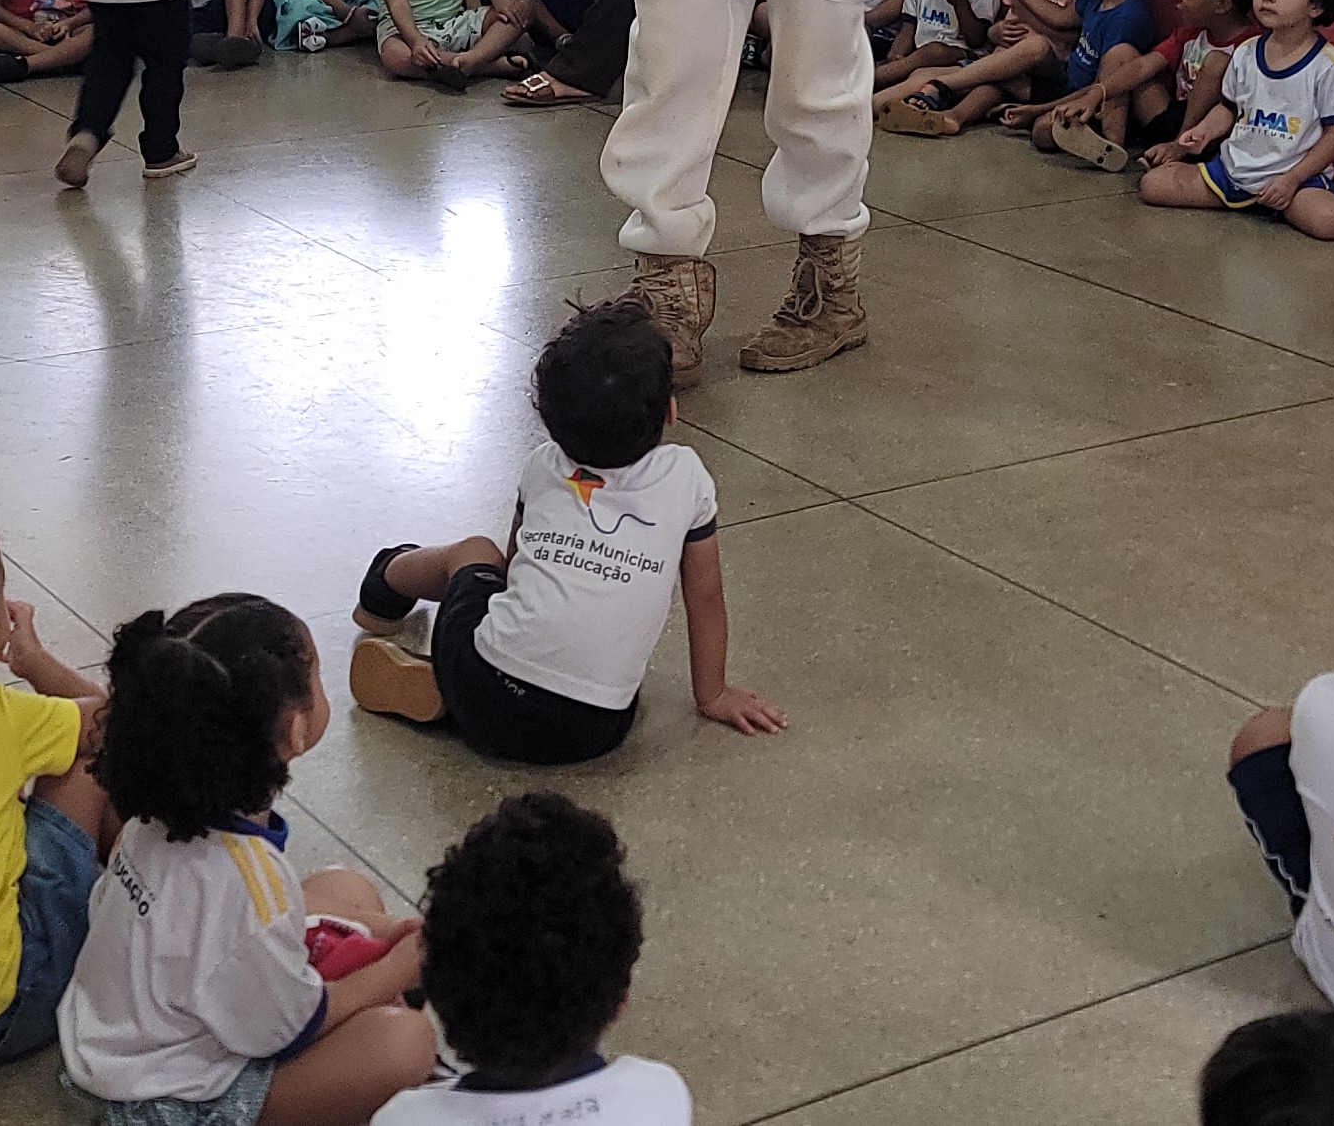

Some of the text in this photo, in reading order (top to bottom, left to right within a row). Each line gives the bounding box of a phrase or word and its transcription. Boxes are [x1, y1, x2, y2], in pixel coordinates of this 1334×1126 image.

[533, 545, 632, 584] da Educação
[588, 539, 665, 575] Municipal
